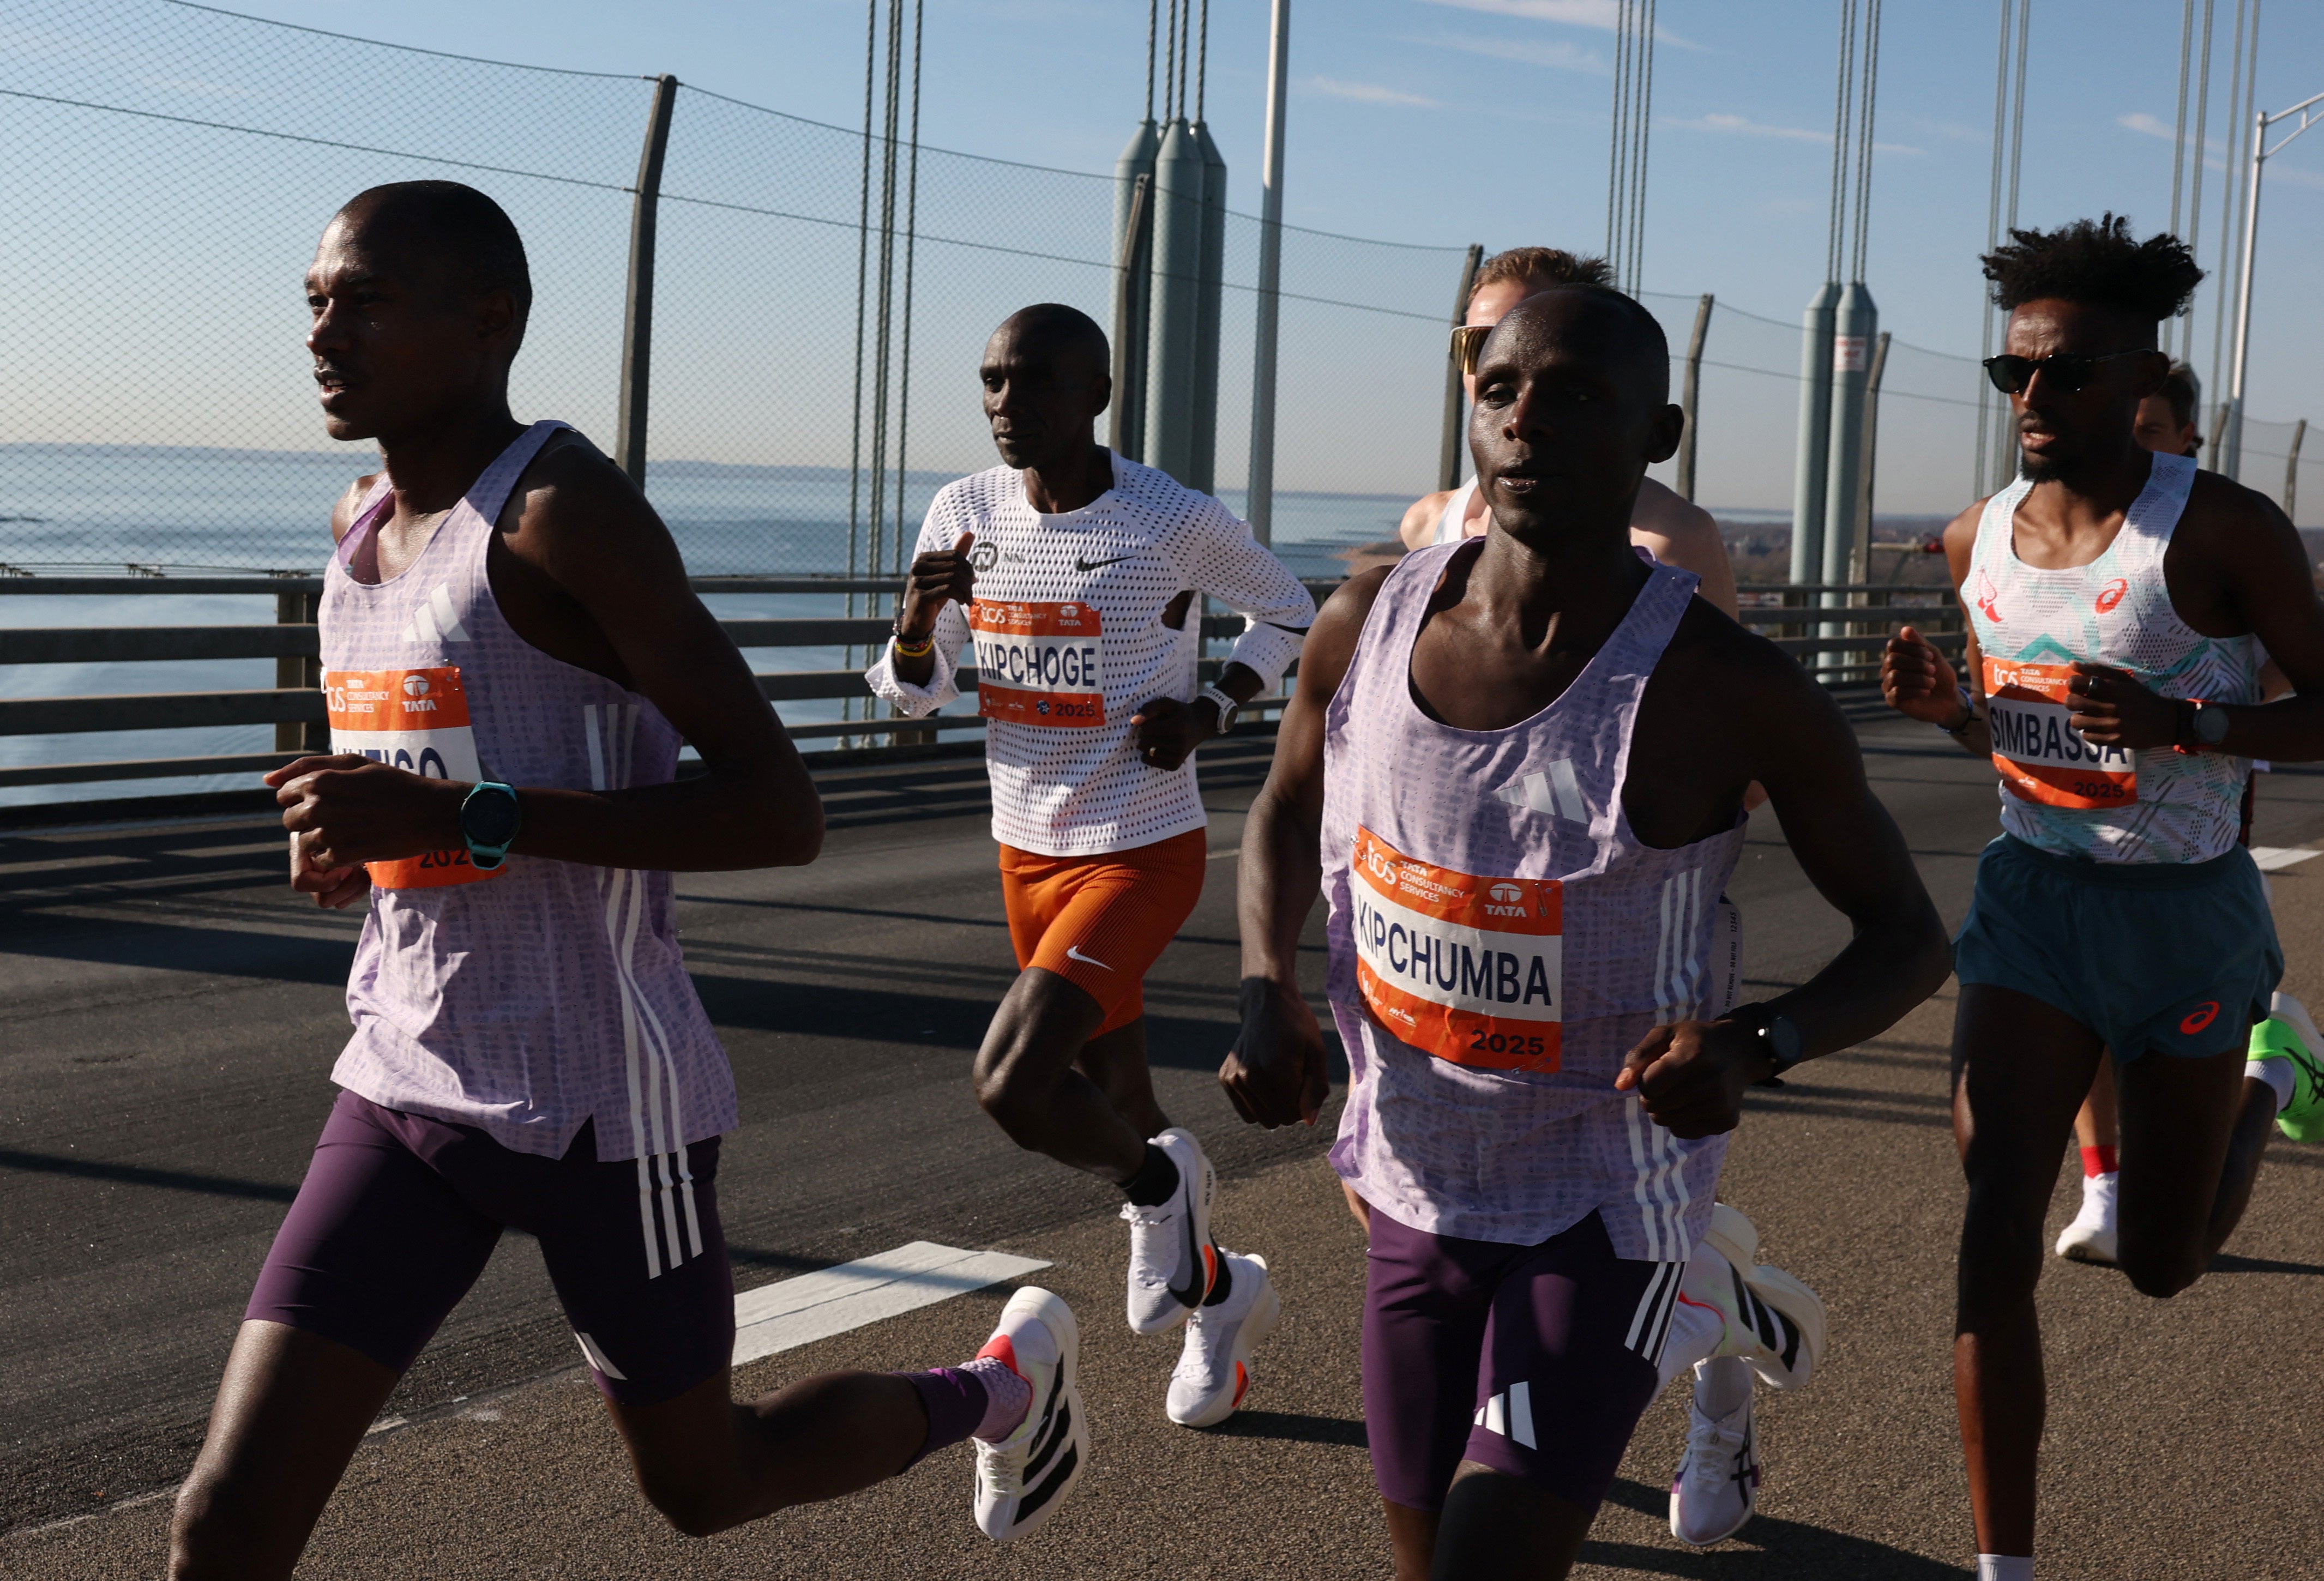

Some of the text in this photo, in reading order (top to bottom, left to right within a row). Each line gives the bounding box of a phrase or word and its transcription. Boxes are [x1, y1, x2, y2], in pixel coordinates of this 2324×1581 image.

[978, 641, 1096, 686] KIPCHOGE
[2020, 676, 2067, 685] CONSULTANCY
[402, 699, 437, 713] TATA
[1055, 703, 1096, 717] 2025
[2074, 782, 2125, 799] 2025
[420, 849, 469, 868] 202
[1367, 840, 1396, 885] tcs
[1400, 860, 1428, 877] TATA
[1399, 882, 1440, 902] SERVICES
[1400, 871, 1465, 898] CONSULTANCY
[1484, 904, 1526, 918] TATA
[1357, 894, 1552, 1006] KIPCHUMBA
[1470, 1030, 1544, 1055] 2025
